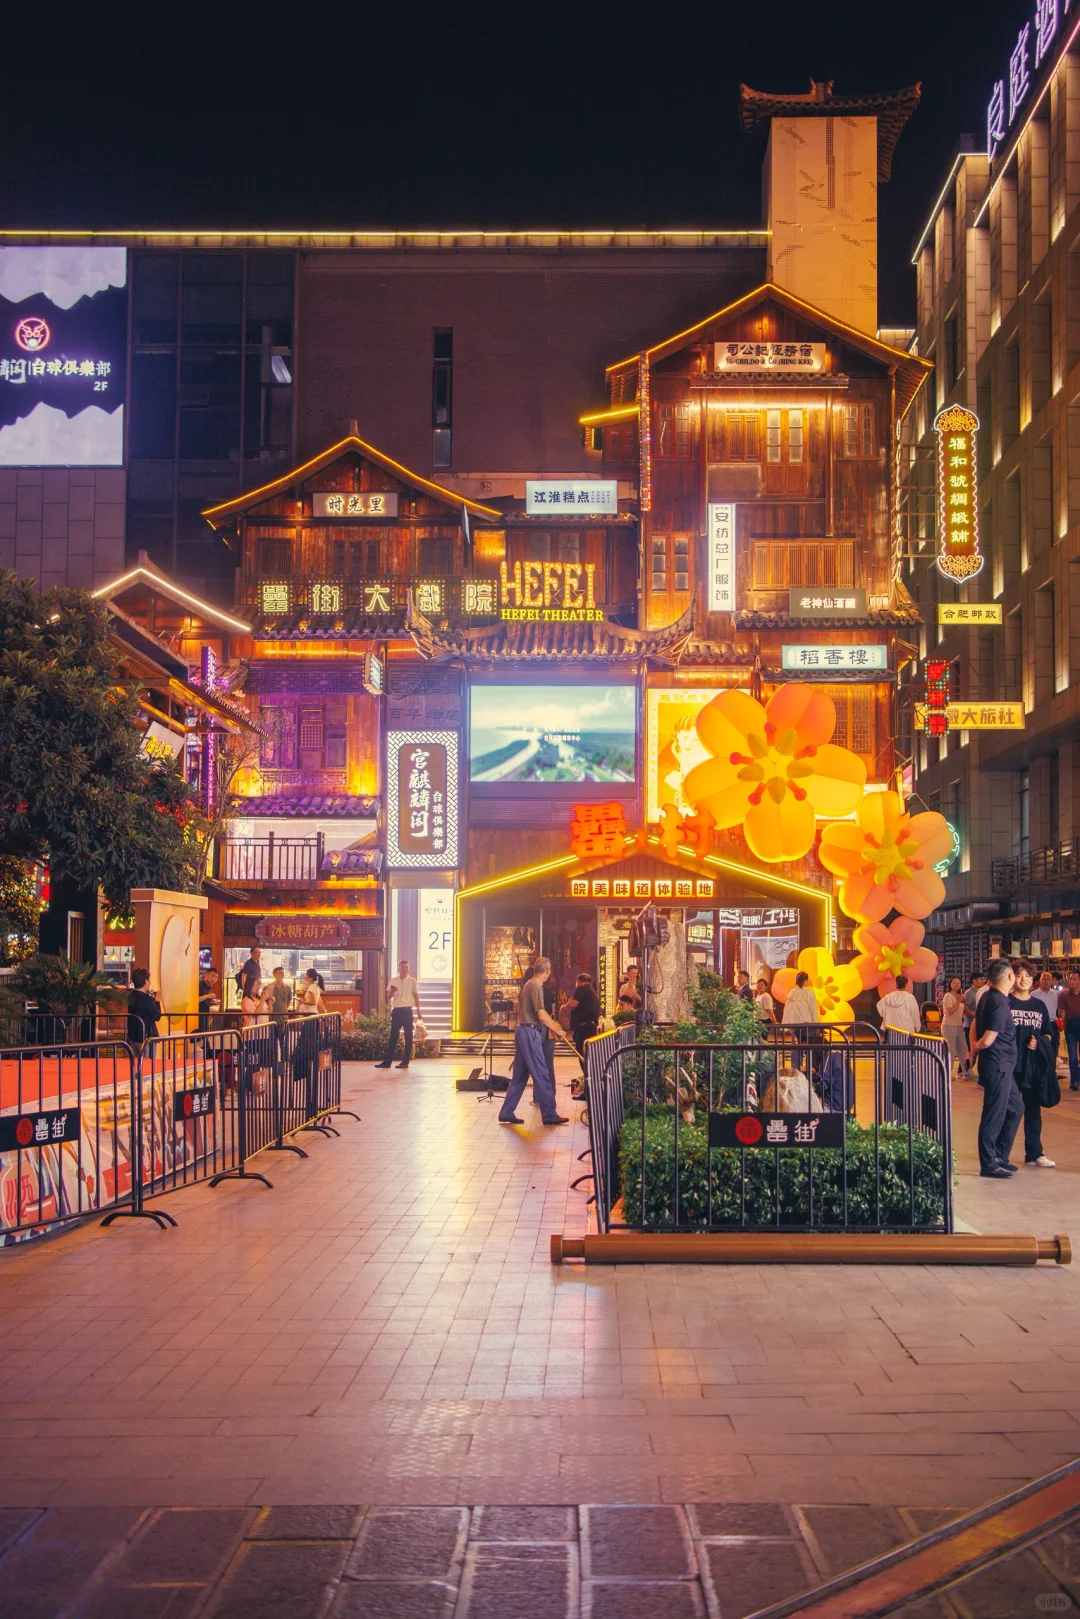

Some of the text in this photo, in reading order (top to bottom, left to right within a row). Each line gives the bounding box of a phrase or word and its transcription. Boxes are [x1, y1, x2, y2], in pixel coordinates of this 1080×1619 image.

[93, 381, 108, 392] 2F
[328, 496, 384, 512] 时光里
[534, 491, 590, 503] 江淮糕点
[715, 512, 729, 600] 安纺总厂服饰
[500, 561, 596, 608] HEFEI
[500, 609, 603, 621] HEFEI THEATER
[943, 609, 997, 619] 合肥邮政
[800, 649, 869, 666] 稻香樓
[573, 882, 712, 896] 皖美味道体验地
[271, 924, 335, 938] 冰糖葫芦
[429, 932, 451, 950] 2F
